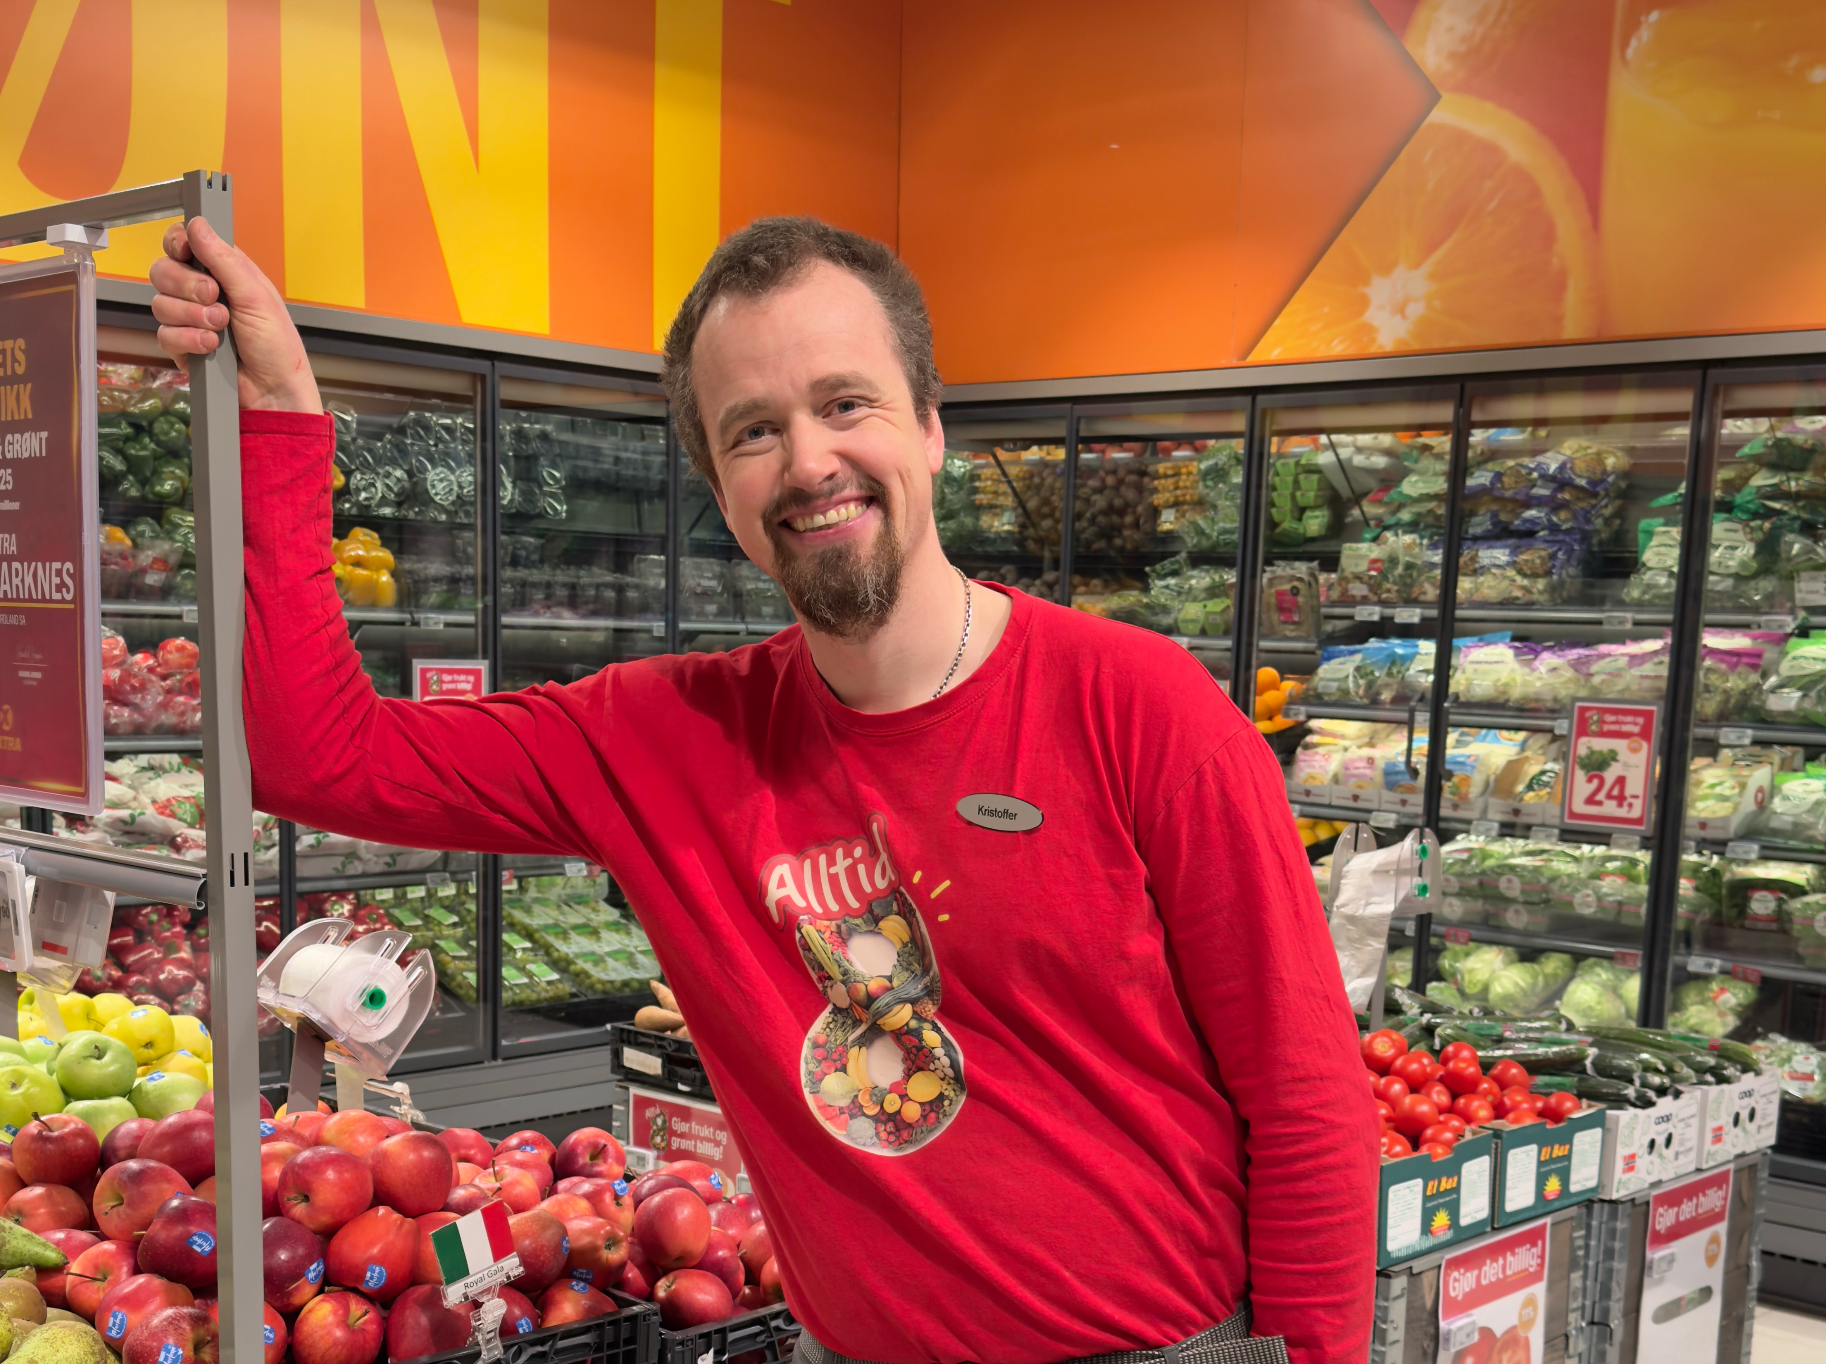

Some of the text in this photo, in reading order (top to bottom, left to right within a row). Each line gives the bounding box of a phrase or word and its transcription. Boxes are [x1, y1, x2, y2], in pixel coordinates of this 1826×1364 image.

[5, 431, 49, 460] GRØNT
[977, 804, 1018, 821] Kristoffer
[765, 822, 896, 924] Alltid
[671, 1116, 727, 1144] Gjør frukt og
[671, 1136, 723, 1161] grønt billig!
[1655, 1183, 1727, 1235] Gjør det billig!
[463, 1264, 505, 1290] Royal Gala
[1448, 1239, 1543, 1301] Gjør det billig!
